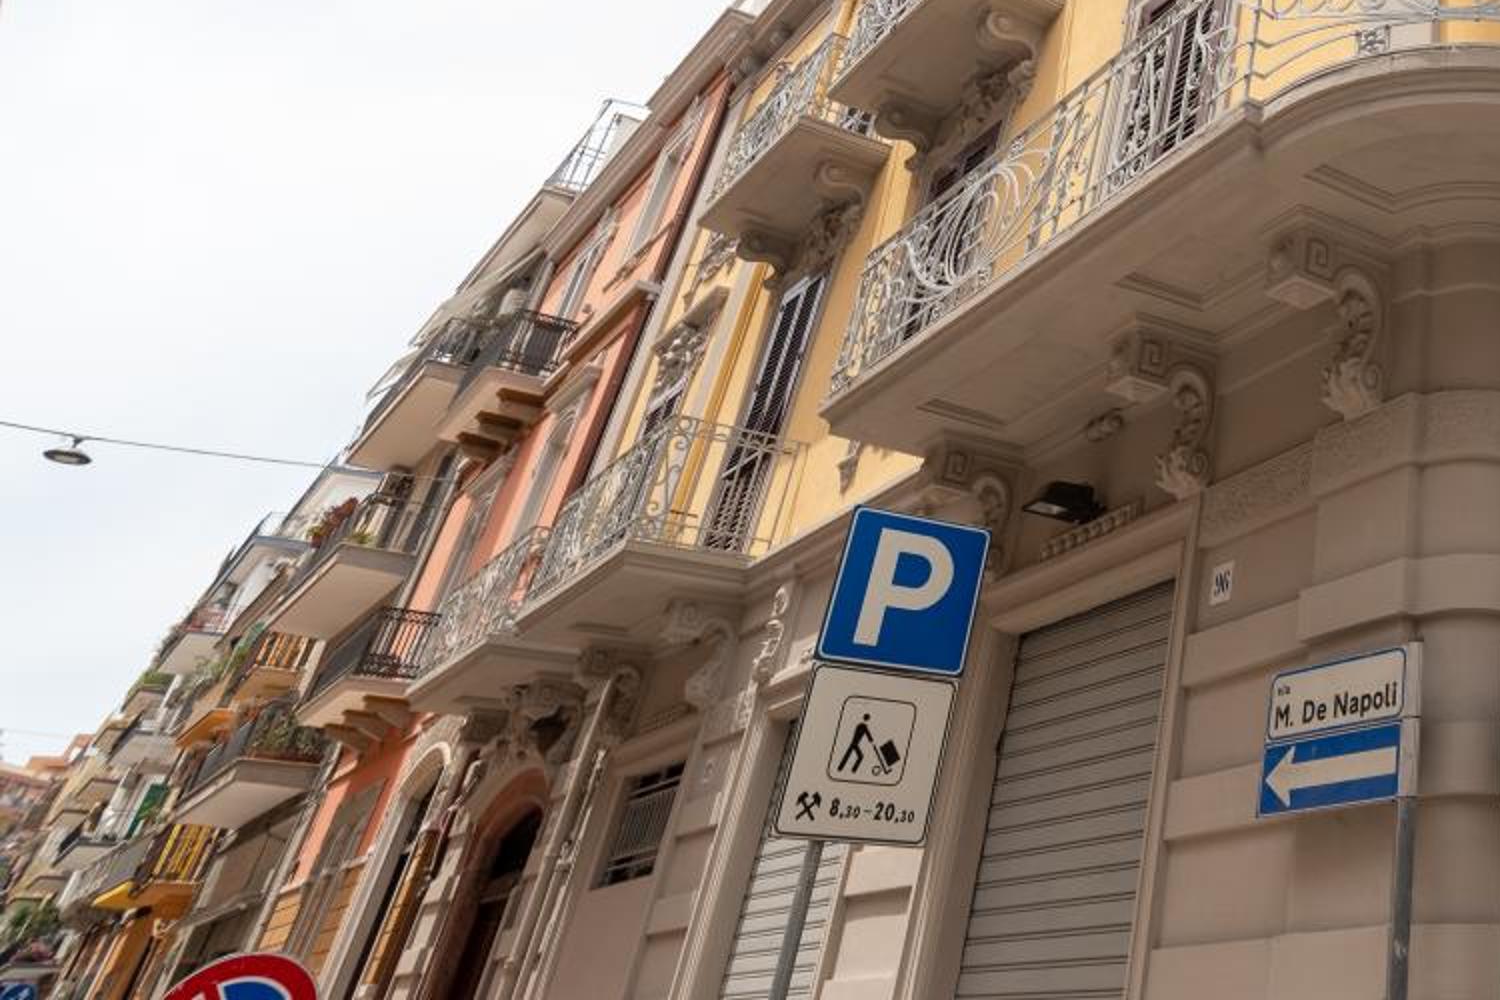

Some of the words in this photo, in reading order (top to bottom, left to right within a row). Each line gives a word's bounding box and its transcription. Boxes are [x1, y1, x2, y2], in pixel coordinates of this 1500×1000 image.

[852, 527, 955, 647] P
[1274, 703, 1293, 730] M.
[1302, 699, 1327, 724] De
[1333, 681, 1398, 718] Napoli
